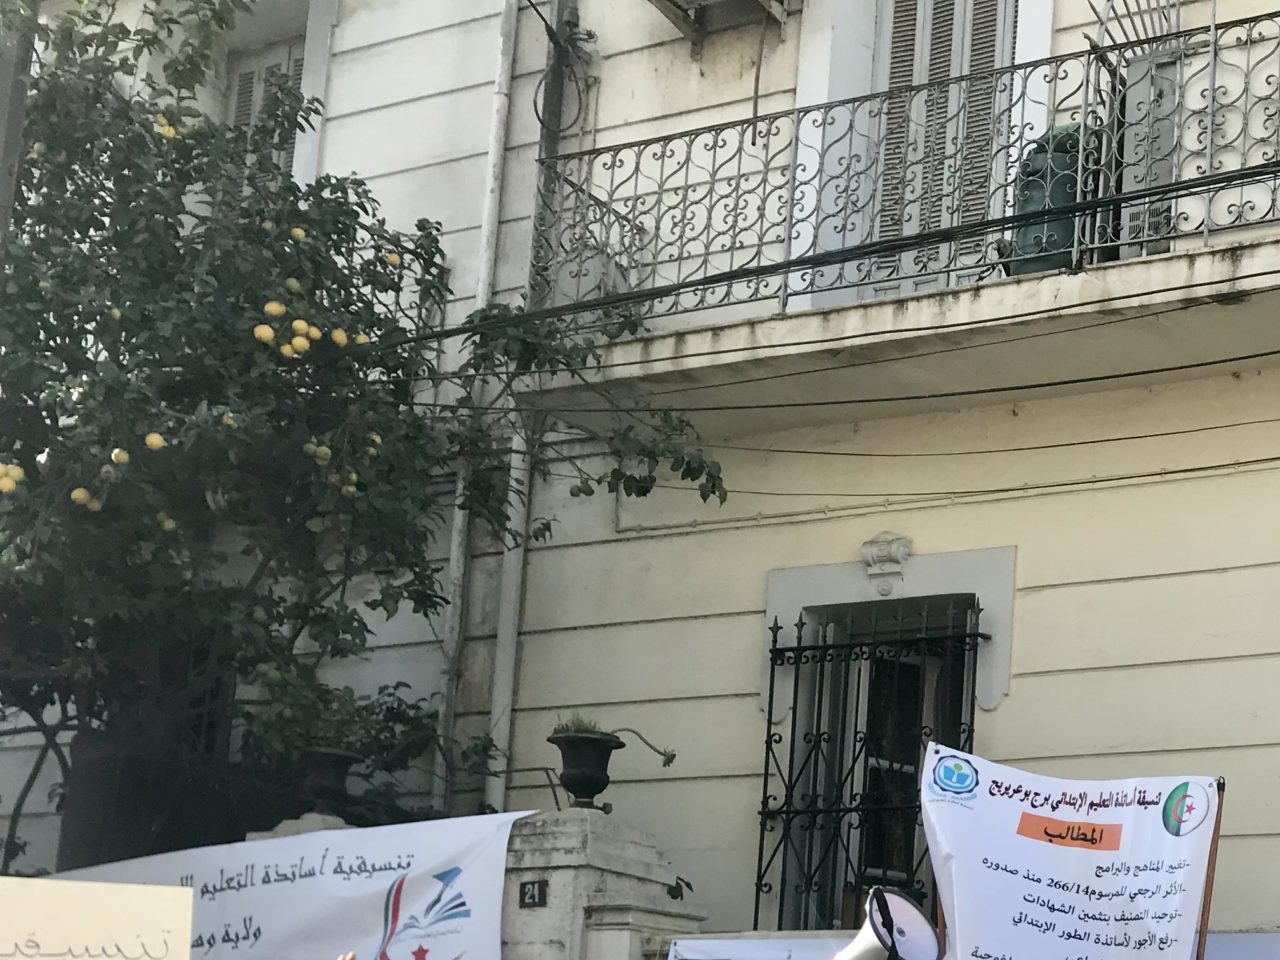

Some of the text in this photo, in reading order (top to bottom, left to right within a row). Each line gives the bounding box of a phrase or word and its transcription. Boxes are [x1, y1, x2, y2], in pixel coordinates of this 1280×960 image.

[1030, 792, 1051, 809] برج
[1086, 791, 1114, 816] التعليم
[1044, 825, 1104, 845] المطالب
[261, 847, 329, 885] أساتذة
[333, 853, 415, 881] تنسيقية
[981, 856, 1020, 876] صدوره
[1095, 862, 1131, 878] والبرامج
[1133, 861, 1164, 878] المناهج
[200, 863, 256, 900] التعليم
[1022, 869, 1043, 885] منذ
[525, 883, 540, 903] 21
[1128, 885, 1162, 902] الرجعي
[1023, 892, 1076, 916] الشهادات
[1012, 910, 1057, 934] الإبتدائي
[1077, 909, 1112, 926] بتثمين
[1113, 909, 1150, 927] التصنيف
[222, 915, 263, 948] ولاية
[1058, 927, 1091, 943] الطور
[1094, 931, 1131, 949] لأساتذة
[1132, 931, 1157, 950] الأجور
